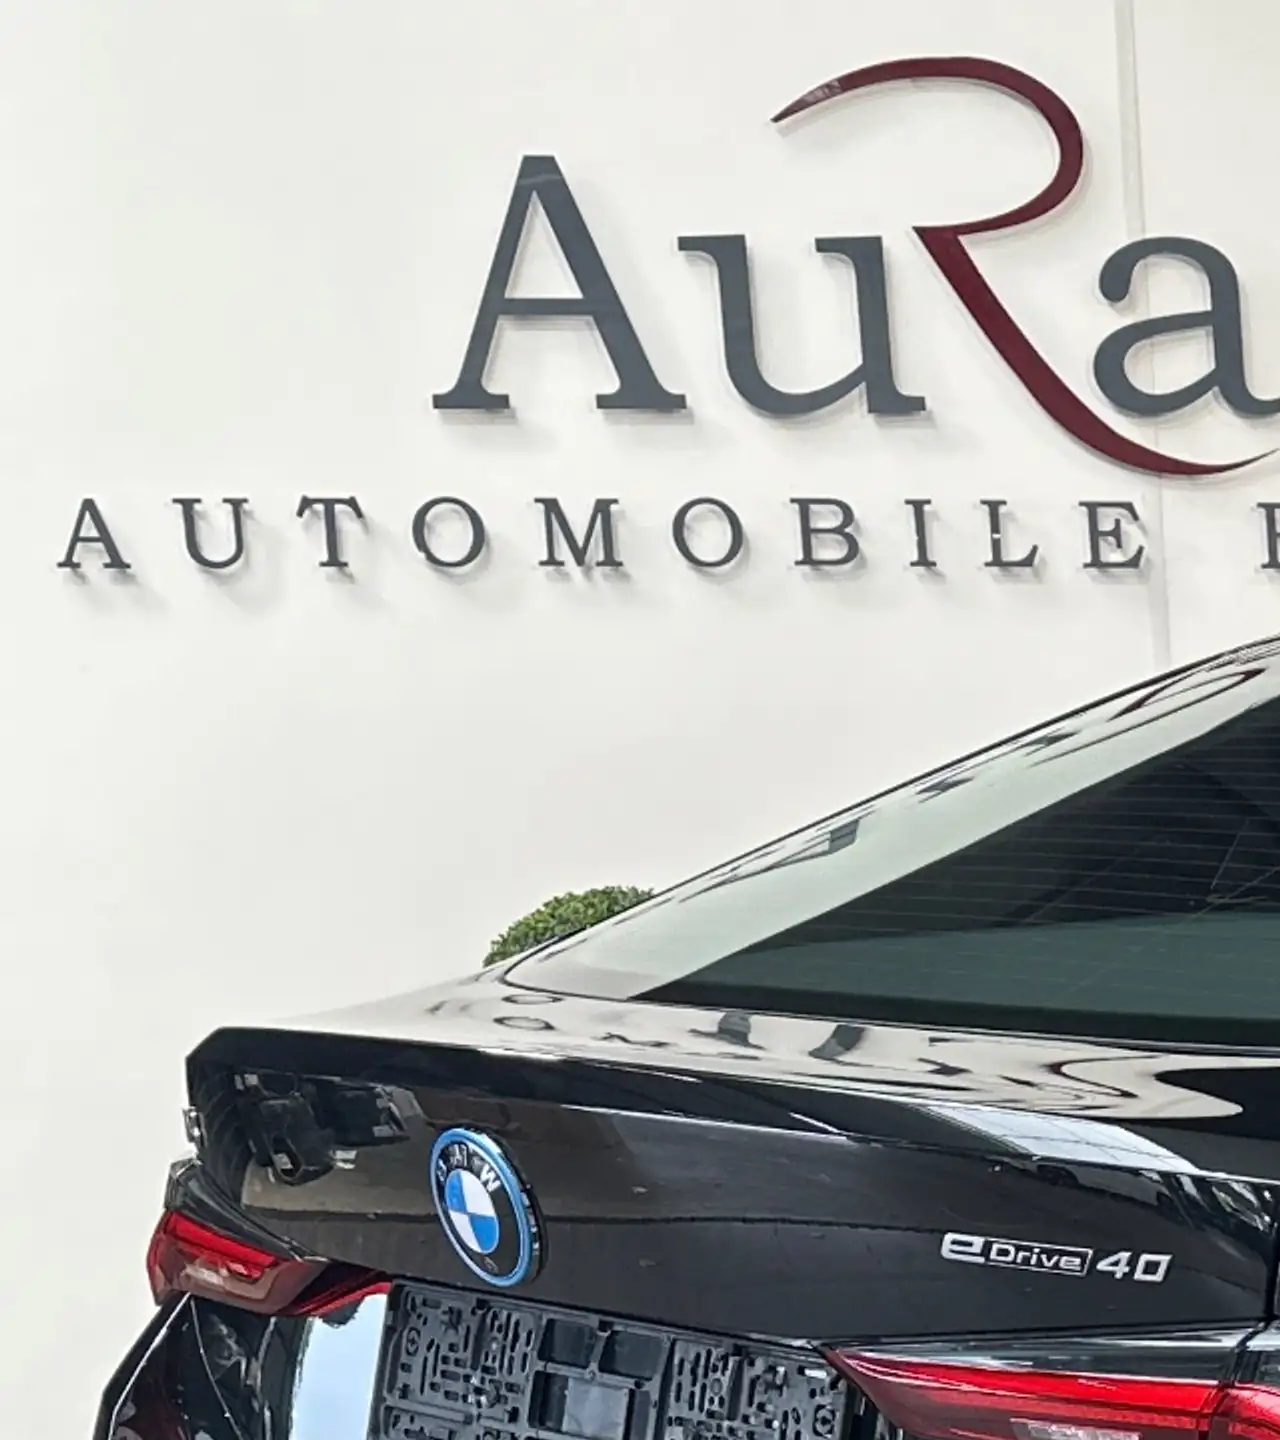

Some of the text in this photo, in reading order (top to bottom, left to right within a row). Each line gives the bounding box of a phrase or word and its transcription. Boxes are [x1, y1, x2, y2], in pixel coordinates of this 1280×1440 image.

[57, 496, 1144, 572] AUTOMOBILE
[940, 1232, 1173, 1282] eDrive 40
